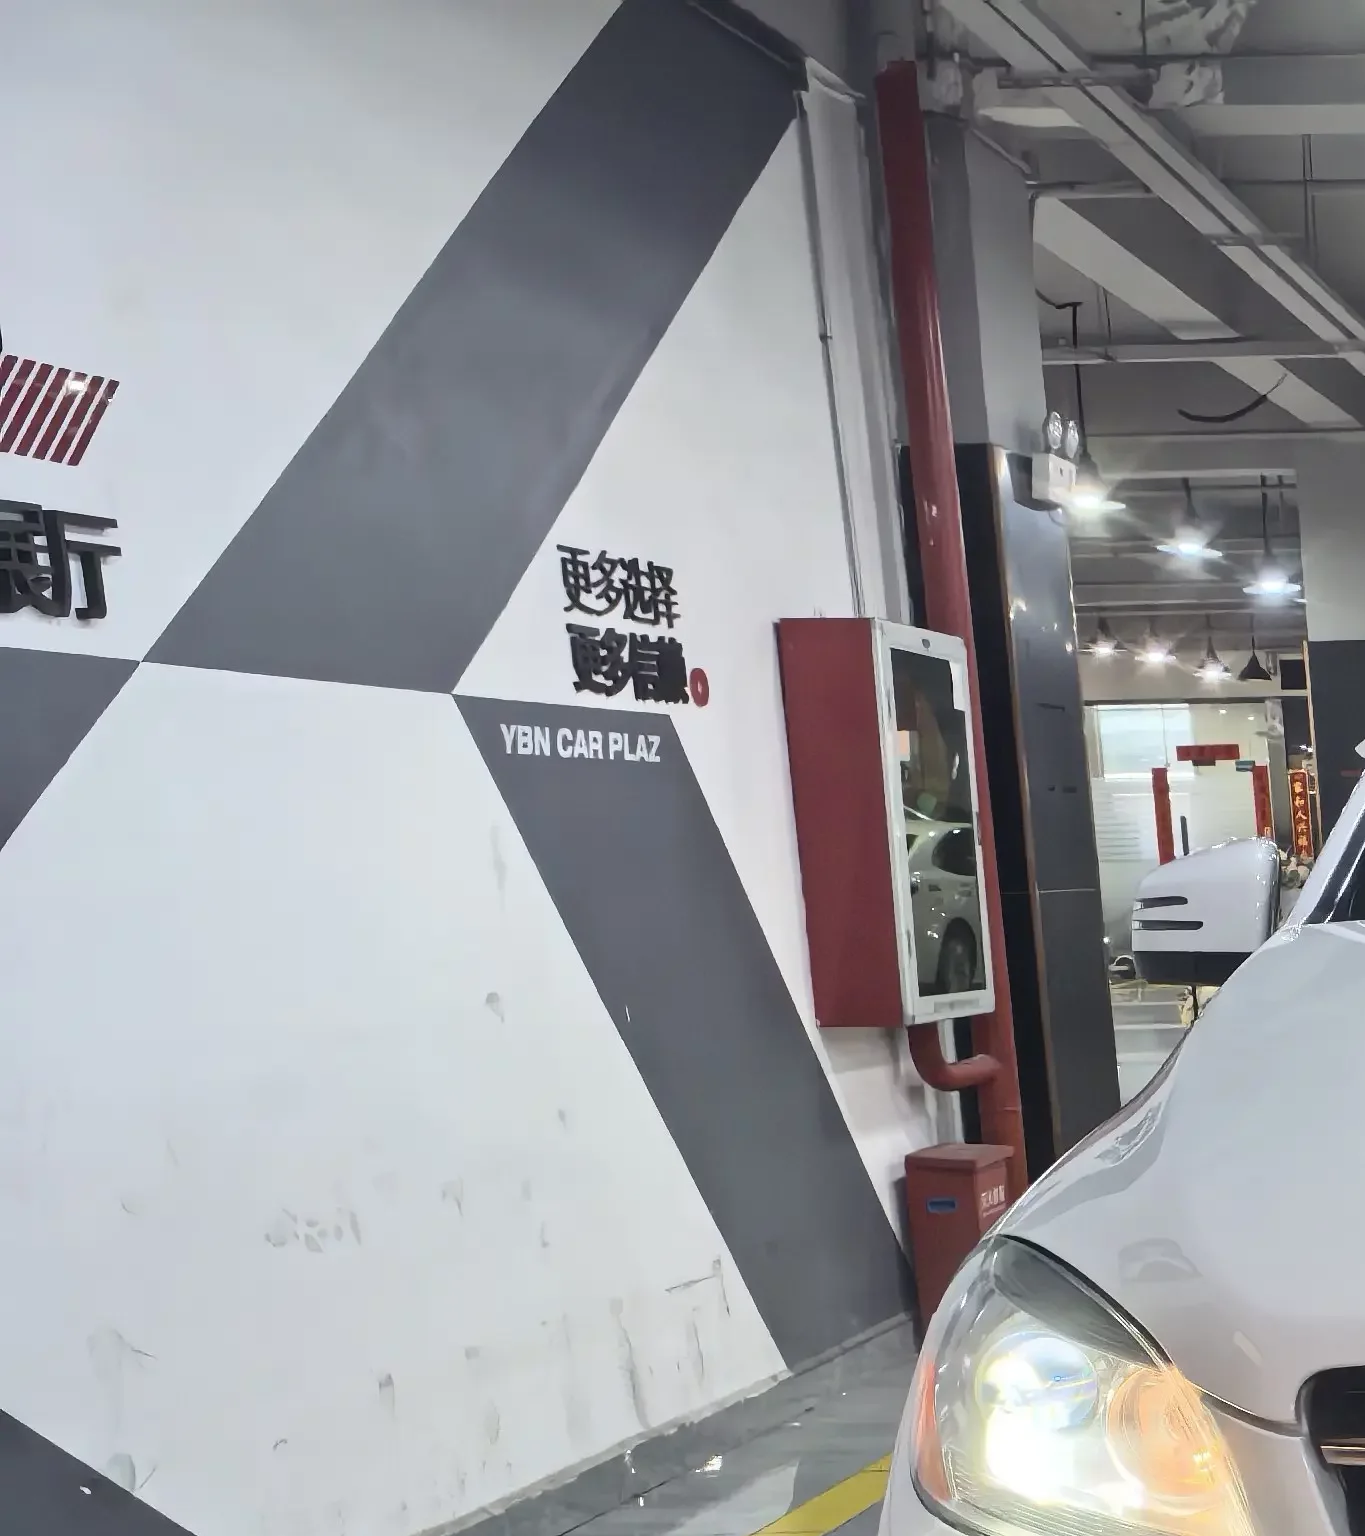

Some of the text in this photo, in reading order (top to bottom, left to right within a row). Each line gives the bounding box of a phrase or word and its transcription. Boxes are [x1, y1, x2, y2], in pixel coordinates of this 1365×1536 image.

[499, 723, 661, 763] YBN CAR PLAZ
